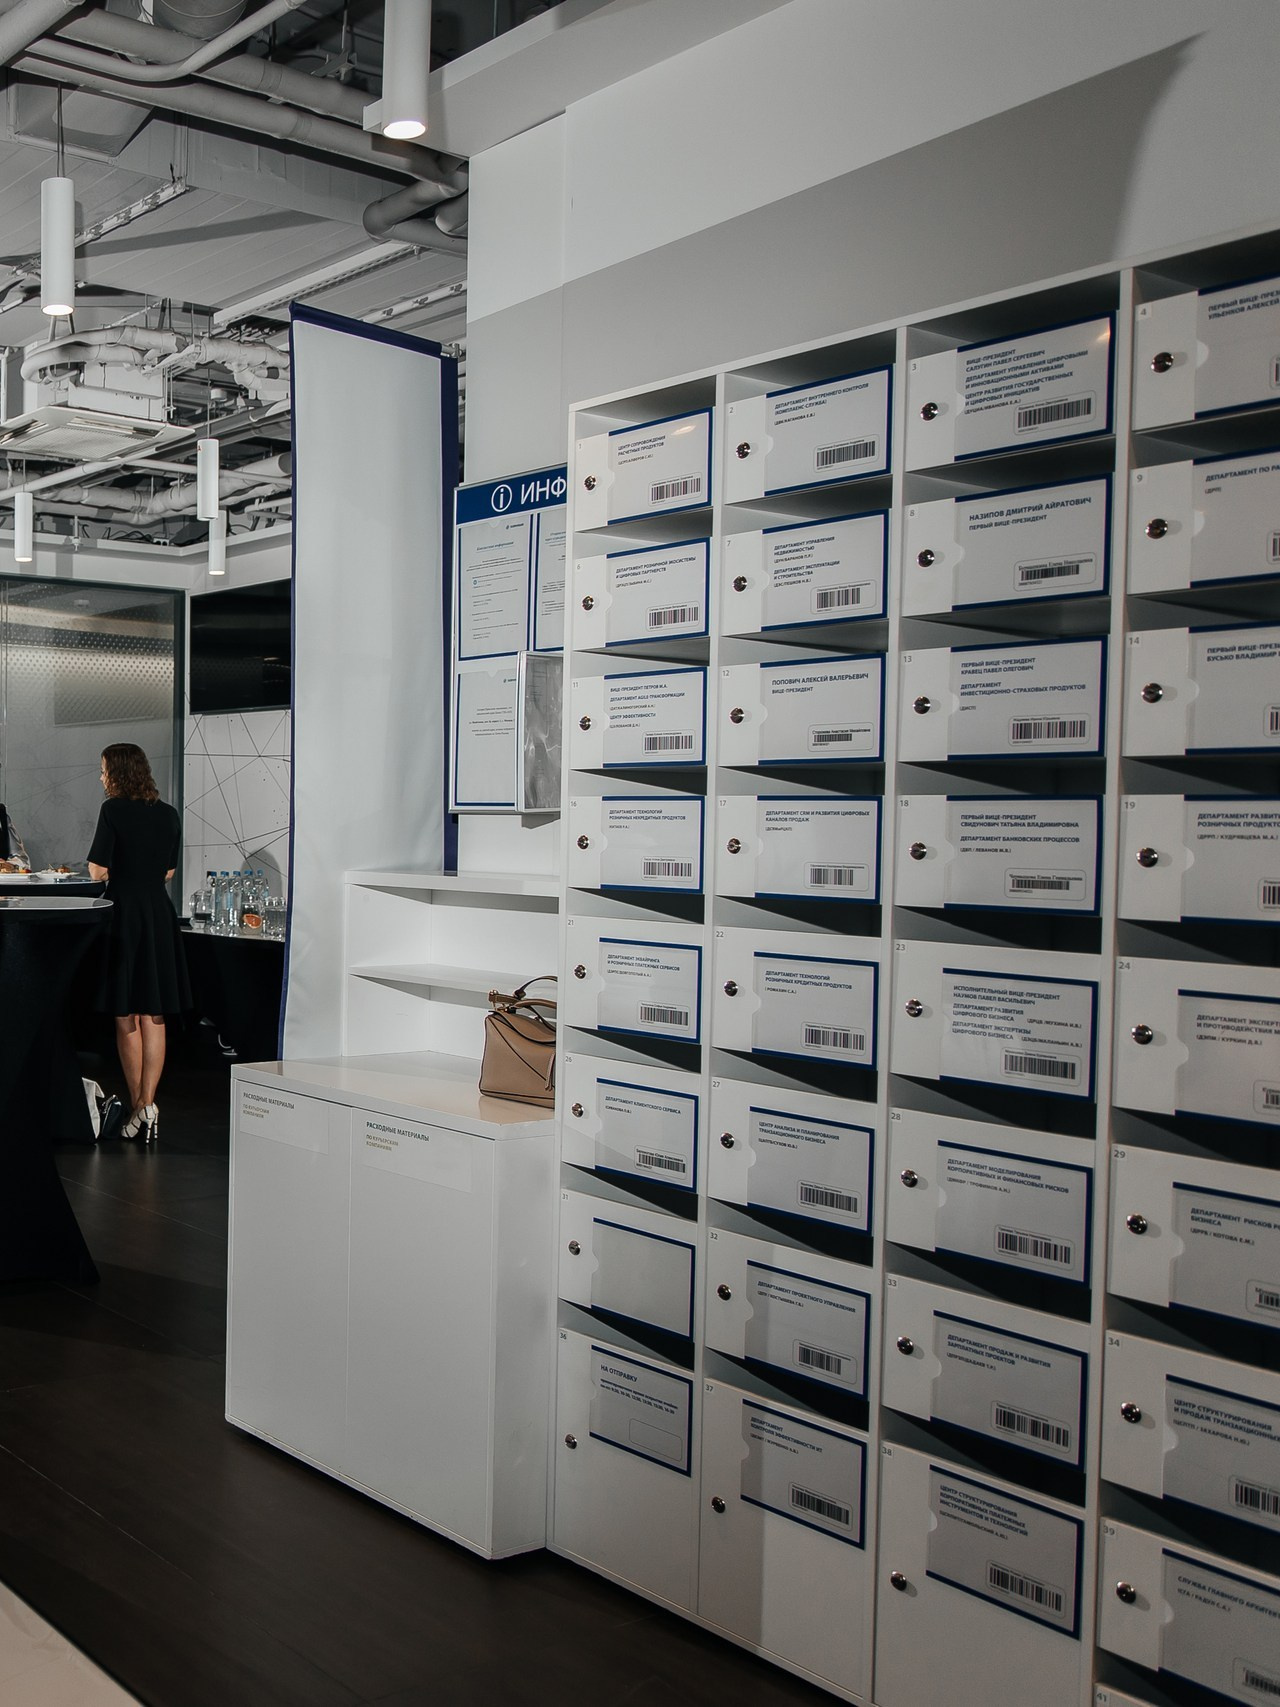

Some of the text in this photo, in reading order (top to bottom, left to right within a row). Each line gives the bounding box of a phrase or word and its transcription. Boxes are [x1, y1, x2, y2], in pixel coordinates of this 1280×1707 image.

[1208, 299, 1237, 313] ПЕРВЫЙ
[1247, 298, 1280, 311] АЛЕКСЕЙ
[966, 349, 1016, 366] ВИЦЕ-ПРЕЗИДЕНТ
[993, 349, 1045, 367] ПАВЕЛ СЕРГЕЕВИЧ
[965, 350, 1088, 383] ДЕПАРТАМЕНТ УПРАВЛЕНИЯ ЦИФРОВЫМИ
[971, 363, 1064, 389] ИННОВАЦИОННЫМИ АКТИВАМИ
[965, 371, 1073, 400] ЦЕНТР РАЗВИТИЯ ГОСУДАРСТВЕННЫХ
[775, 382, 869, 410] ДЕПАРТАМЕНТ КОНТРОЛЯ
[970, 386, 1040, 406] ЦИФРОВЫХ ИНИЦИАТИВ
[729, 406, 734, 414] 2
[631, 435, 666, 448] СОПРОВОЖДЕНИЯ
[641, 442, 664, 451] ПРОДУКТОВ
[1137, 474, 1143, 482] 9
[1205, 468, 1257, 482] ДЕПАРТАМЕНТ
[910, 509, 915, 517] 8
[969, 496, 1091, 522] НАЗИПОВ ДМИТРИЙ АЙРАТОВИЧ
[969, 514, 1047, 531] ПЕРВЫЙ ВИЦЕ-ПРЕЗИДЕНТ
[806, 536, 835, 545] УПРАВЛЕНИЯ
[616, 565, 643, 573] ДЕПАРТАМЕНТ
[774, 566, 804, 575] ДЕПАРТАМЕНТ
[1129, 637, 1140, 645] 14
[1207, 646, 1236, 654] ПЕРВЫЙ
[1235, 651, 1277, 660] ВЛАДИМИР
[903, 655, 912, 663] 13
[985, 657, 1035, 667] ВИЦЕ-ПРЕЗИДЕНТ
[1003, 665, 1033, 673] ОЛЕГОВИЧ
[772, 673, 869, 686] ПОПОВИЧ АЛЕКСЕЙ ВАЛЕРЬЕВИЧ
[960, 682, 1001, 690] ДЕПАРТАМЕНТ
[1049, 684, 1086, 692] ПРОДУКТОВ
[900, 799, 909, 807] 18
[1124, 801, 1135, 809] 19
[896, 943, 906, 951] 23
[1118, 961, 1130, 970] 24
[765, 970, 798, 978] ДЕПАРТАМЕНТ
[794, 979, 822, 987] КРЕДИТНЫХ
[953, 985, 1060, 1001] ИСПОЛНИТЕЛЬНЫЙ ВИЦЕ-ПРЕЗИДЕНТ
[953, 992, 1035, 1006] НАУМОВ ПАВЕЛ ВАСИЛЬЕВИЧ
[953, 1003, 993, 1013] ДЕПАРТАМЕНТ
[953, 1010, 987, 1019] ЦИФРОВОГО
[1197, 1014, 1246, 1025] ДЕПАРТАМЕНТ
[952, 1021, 992, 1031] ДЕПАРТАМЕНТ
[1203, 1022, 1272, 1035] ПРОТИВОДЕЙСТВИЯ
[952, 1028, 987, 1037] ЦИФРОВОГО
[243, 1092, 295, 1110] РАСХОДНЫЕ МАТЕРИАЛЫ
[605, 1096, 681, 1115] ДЕПАРТАМЕНТ СЕРВИСА
[891, 1112, 901, 1120] 28
[366, 1121, 430, 1142] РАСХОДНЫЕ МАТЕРИАЛЫ
[759, 1121, 839, 1141] ЦЕНТР АНАЛИЗА ПЛАНИРОВАНИЯ
[805, 1136, 825, 1145] БИЗНЕСА
[1114, 1150, 1125, 1158] 29
[947, 1158, 1041, 1181] ДЕПАРТАМЕНТ МОДЕЛИРОВАНИЯ
[1002, 1175, 1069, 1193] ФИНАНСОВЫХ РИСКОВ
[1191, 1207, 1272, 1228] ДЕПАРТАМЕНТ РИСКОВ
[1191, 1215, 1221, 1226] БИЗНЕСА
[710, 1232, 718, 1240] 32
[887, 1279, 897, 1287] 33
[758, 1281, 856, 1313] ДЕПАРТАМЕНТ ПРОЕКТНОГО УПРАВЛЕНИЯ
[1108, 1338, 1120, 1347] 34
[947, 1333, 1051, 1369] ДЕПАРТАМЕНТ ПРОДАЖ РАЗВИТИЯ
[947, 1341, 1015, 1366] ЗАРПЛАТНЫХ ПРОЕКТОВ
[609, 1367, 637, 1383] ОТПРАВКУ
[706, 1384, 714, 1392] 37
[1174, 1397, 1196, 1410] ЦЕНТР
[1180, 1407, 1211, 1422] ПРОДАЖ
[751, 1416, 783, 1433] ДЕПАРТАМЕНТ
[751, 1423, 774, 1436] КОНТРОЛЯ
[882, 1447, 892, 1456] 38
[940, 1484, 958, 1496] ЦЕНТР
[940, 1498, 1028, 1537] ИНСТРУМЕНТОВ ТЕХНОЛОГИЙ
[989, 1510, 1025, 1528] ПЛАТЕЖНЫХ
[1103, 1525, 1115, 1535] 39
[1178, 1575, 1244, 1606] СЛУЖБА ГЛАВНОГО
